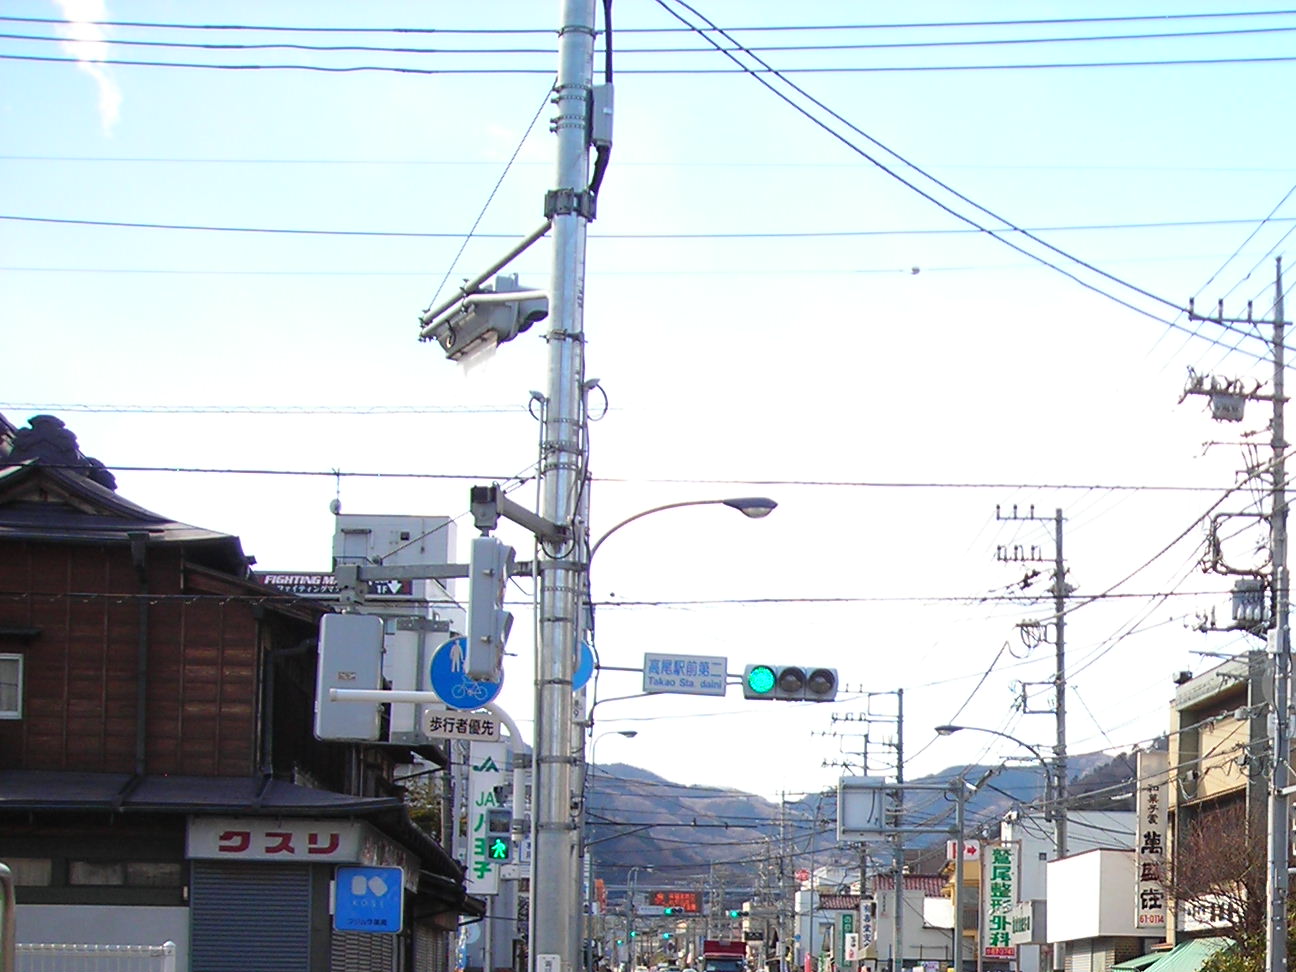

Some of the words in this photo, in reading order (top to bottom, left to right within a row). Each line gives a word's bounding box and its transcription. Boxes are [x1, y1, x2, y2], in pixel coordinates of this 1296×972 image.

[264, 574, 321, 585] FIGHTING
[649, 658, 722, 678] 高尾駅前第二
[648, 676, 676, 687] Takao
[700, 679, 722, 689] daini
[430, 717, 494, 735] 歩行者優先
[218, 830, 340, 855] クスリ
